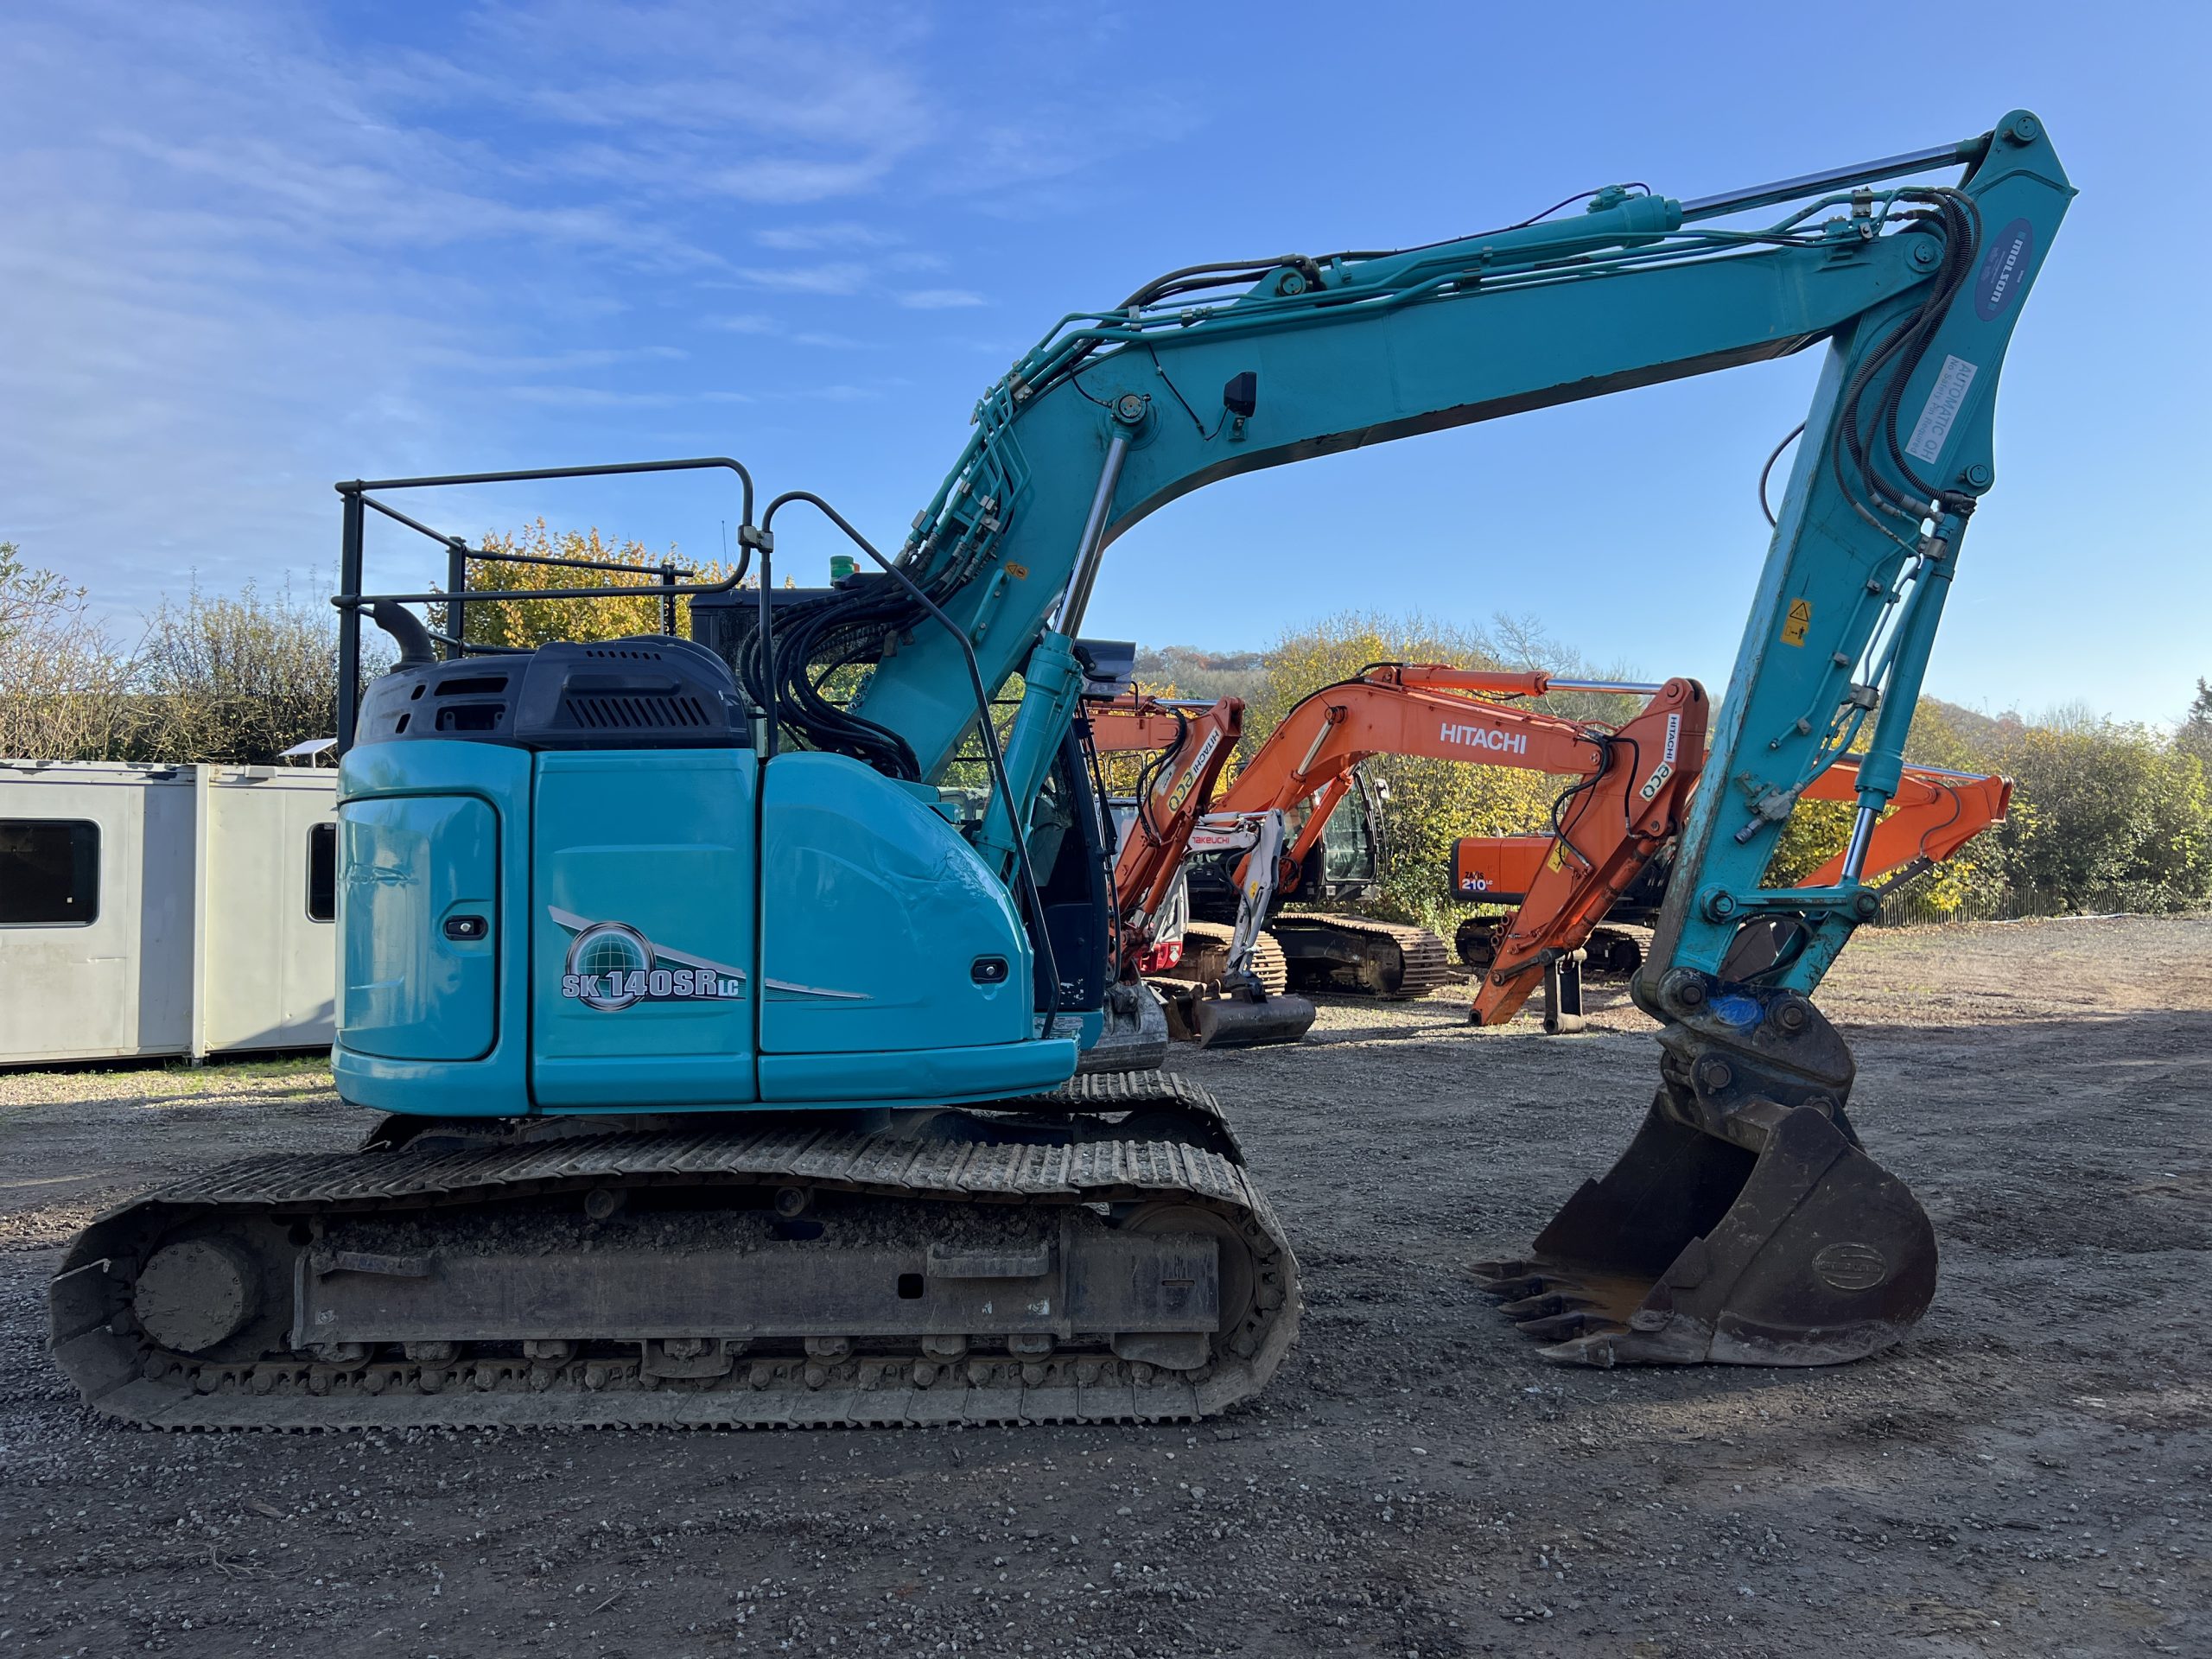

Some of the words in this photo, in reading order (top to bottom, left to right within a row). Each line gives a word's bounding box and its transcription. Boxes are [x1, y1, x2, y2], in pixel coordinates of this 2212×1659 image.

[1947, 358, 1958, 372] No
[1932, 363, 1972, 436] AUTOMATIC
[1910, 418, 1932, 454] Required
[1920, 441, 1938, 462] QH
[1192, 730, 1219, 773] HITACHI
[1440, 722, 1527, 754] HITACHI
[1666, 716, 1677, 760] HITACHI
[1168, 771, 1193, 812] eco
[1642, 764, 1669, 798] eco
[1461, 878, 1486, 891] 210
[562, 973, 600, 998] SK
